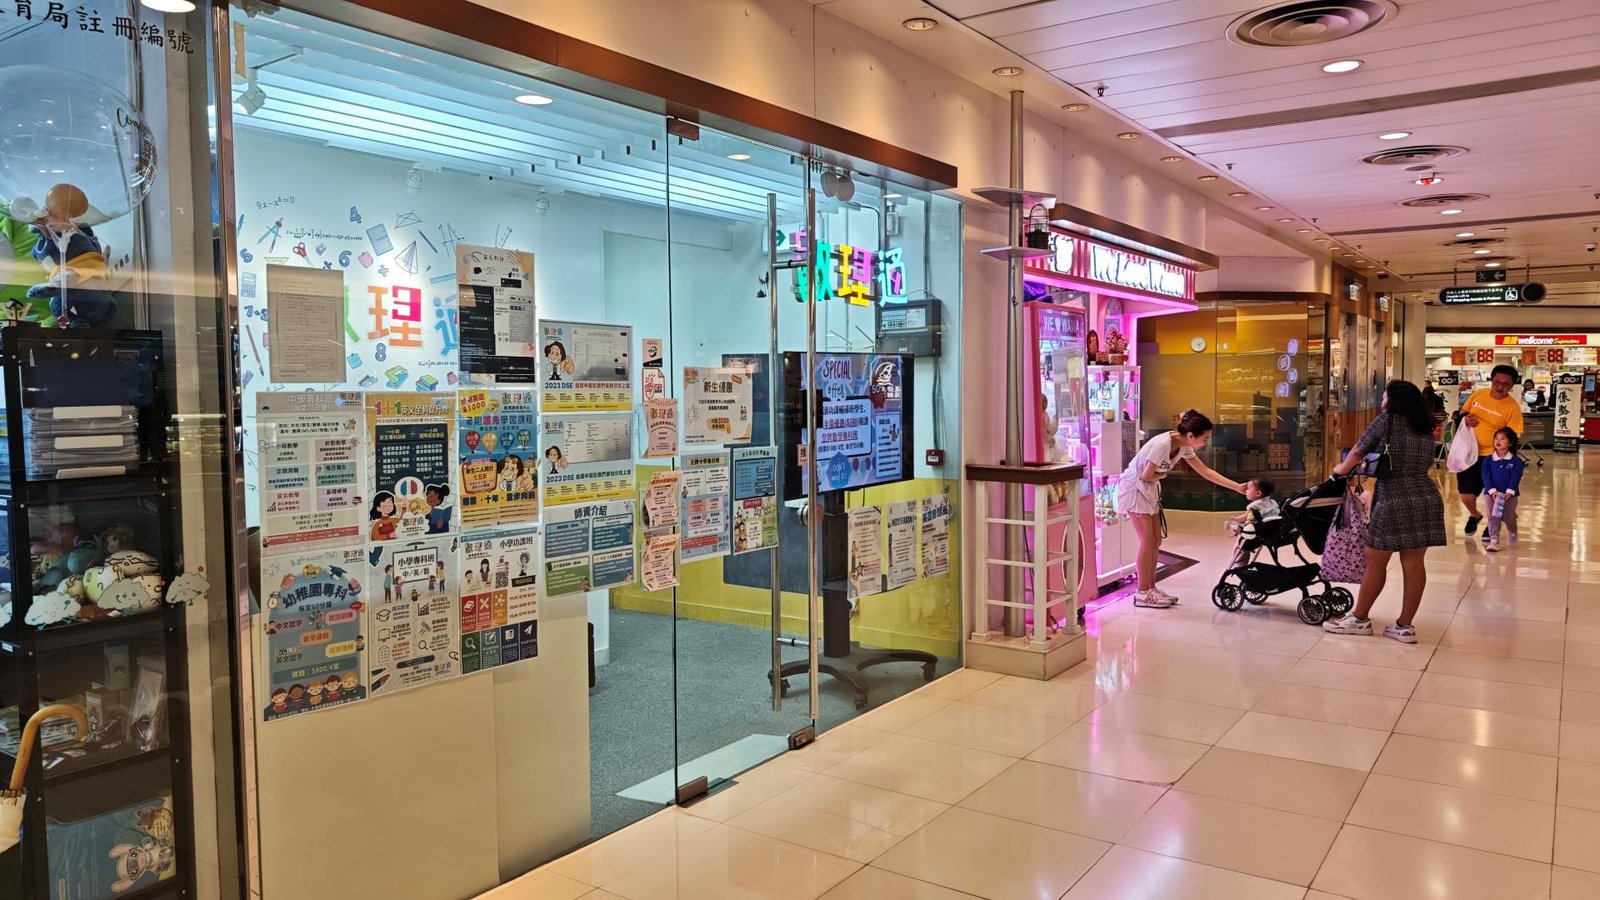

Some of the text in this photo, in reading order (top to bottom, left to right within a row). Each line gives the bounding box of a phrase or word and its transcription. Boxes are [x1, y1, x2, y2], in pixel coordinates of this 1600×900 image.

[0, 0, 194, 54] 育局註冊編號
[349, 206, 362, 224] 4
[339, 250, 352, 267] 6
[1518, 336, 1553, 345] wellcome
[375, 343, 386, 361] 8
[1477, 348, 1494, 362] 88
[1547, 348, 1564, 363] 88
[823, 360, 851, 380] SPECIAL
[703, 381, 733, 393] 新生優惠
[462, 401, 486, 413] $1000
[562, 474, 575, 482] DSE
[574, 505, 608, 519] 師資介紹
[397, 554, 435, 567] 小學專科班
